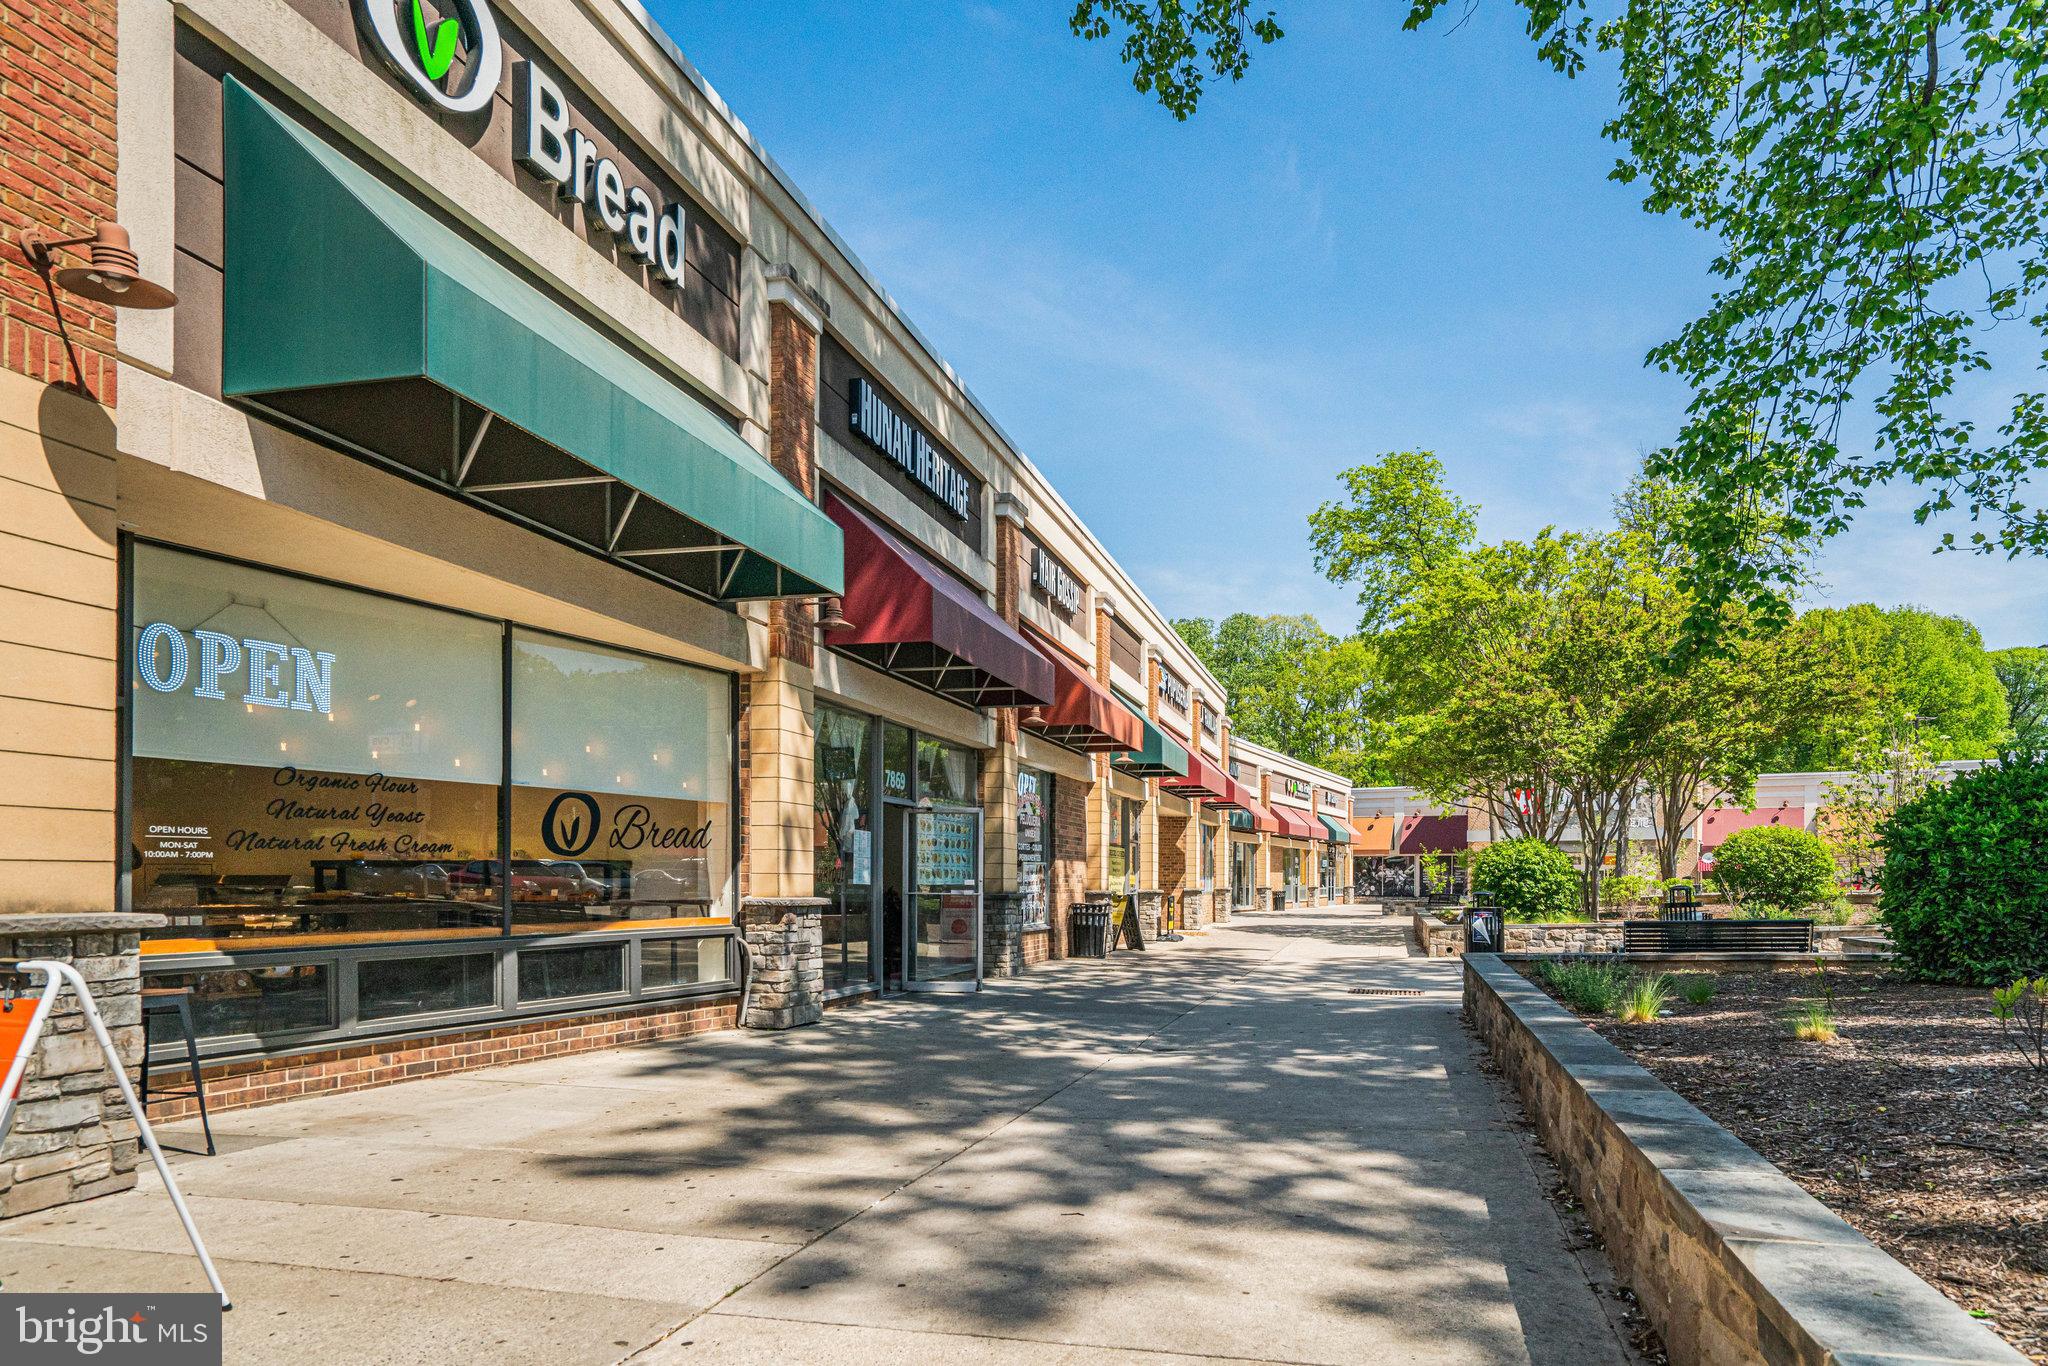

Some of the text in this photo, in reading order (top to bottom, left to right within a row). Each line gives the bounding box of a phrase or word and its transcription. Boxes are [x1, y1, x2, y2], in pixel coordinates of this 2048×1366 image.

[528, 60, 686, 289] Bread
[861, 378, 969, 520] HUNAN HERITAGE
[1039, 548, 1056, 596] HAIR
[138, 622, 336, 714] OPEN
[273, 766, 419, 793] Organic Flour
[885, 769, 906, 791] 7869
[265, 798, 426, 828] Natural Yeast
[609, 804, 712, 850] Bread
[149, 825, 209, 835] OPEN HOURS
[225, 829, 454, 853] Natural Fresh Cream
[144, 850, 179, 858] 10:00AM
[185, 851, 213, 859] 7:00PM
[159, 841, 198, 849] MON-SAT
